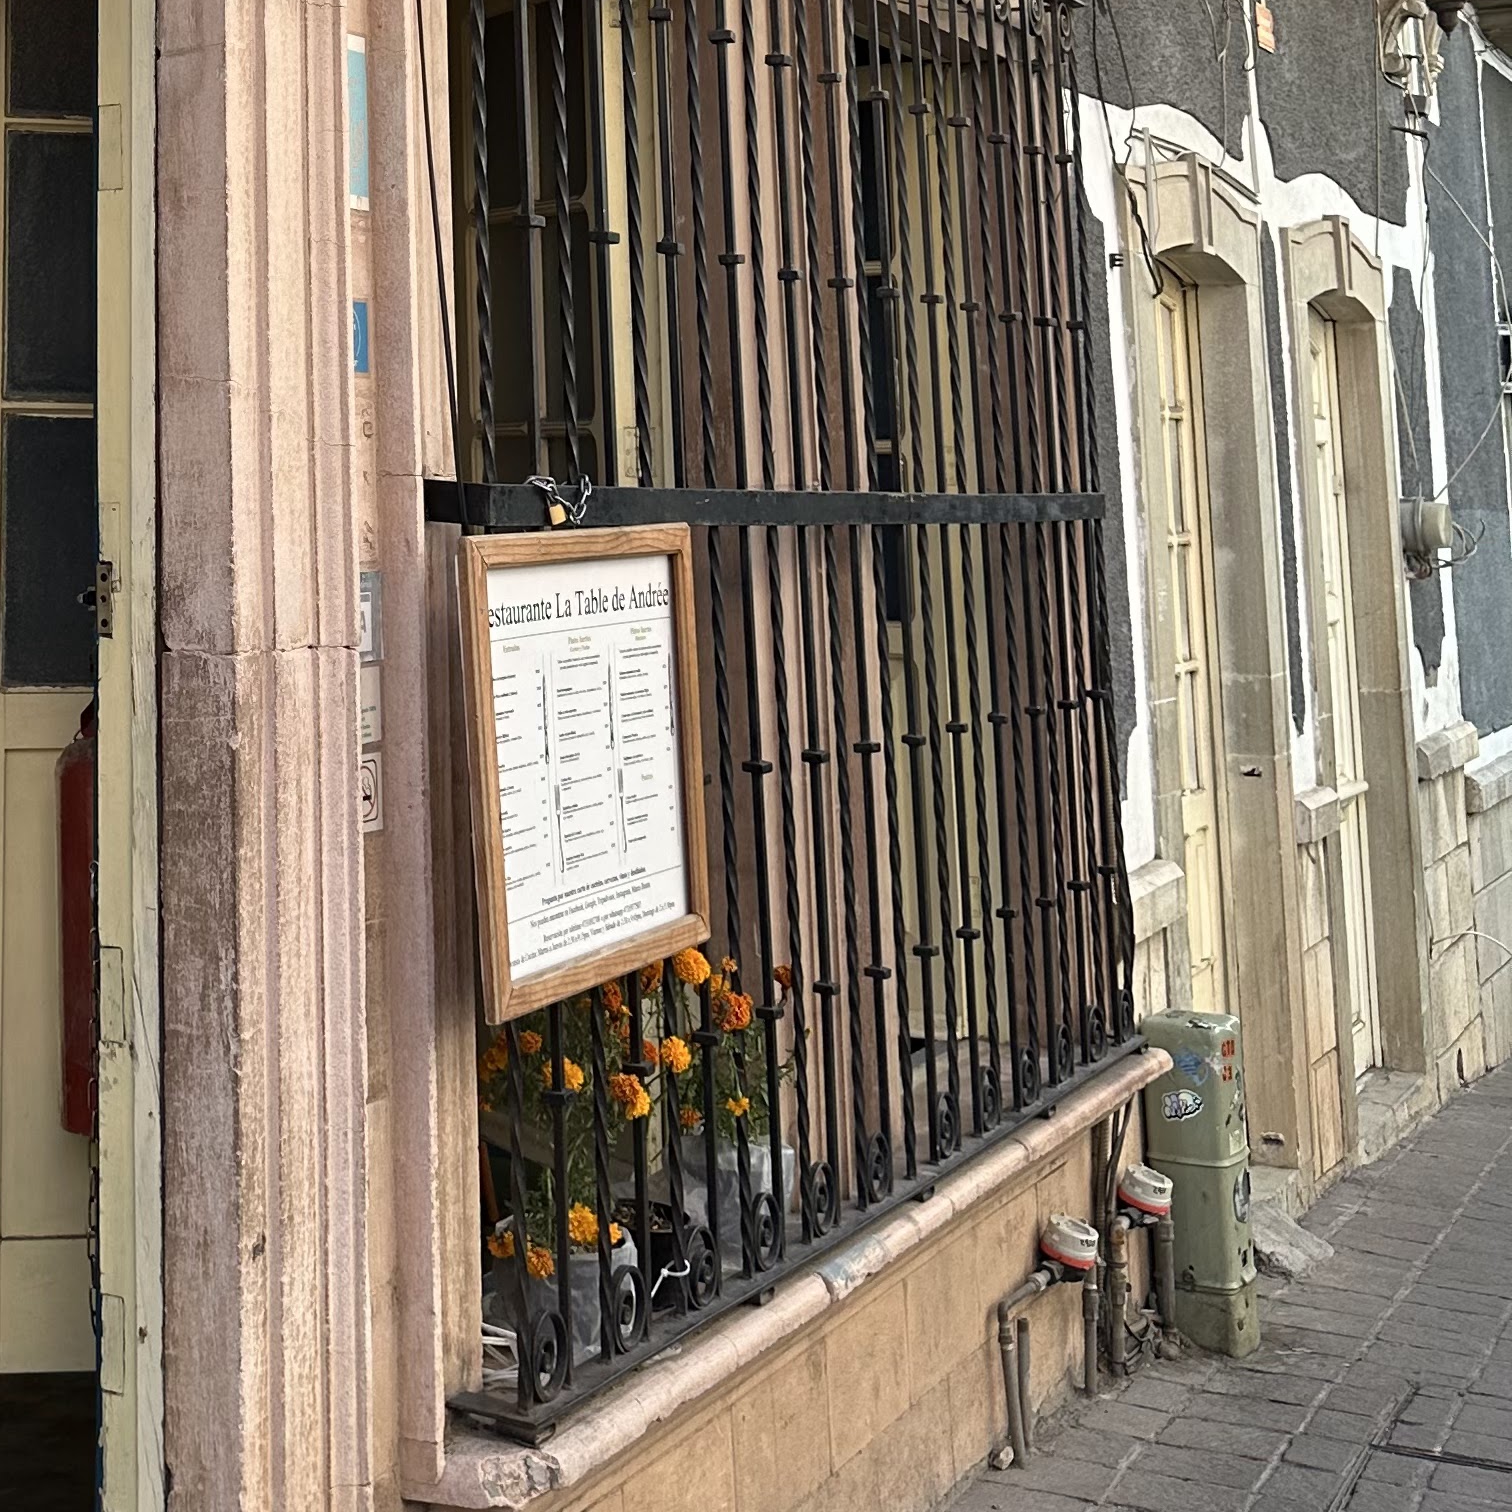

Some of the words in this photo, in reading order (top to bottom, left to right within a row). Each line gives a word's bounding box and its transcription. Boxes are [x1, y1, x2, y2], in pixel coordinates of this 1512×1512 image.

[488, 598, 552, 628] estaurante
[555, 592, 572, 619] La
[574, 588, 609, 616] Table
[611, 585, 626, 612] de
[628, 581, 669, 610] Andrée
